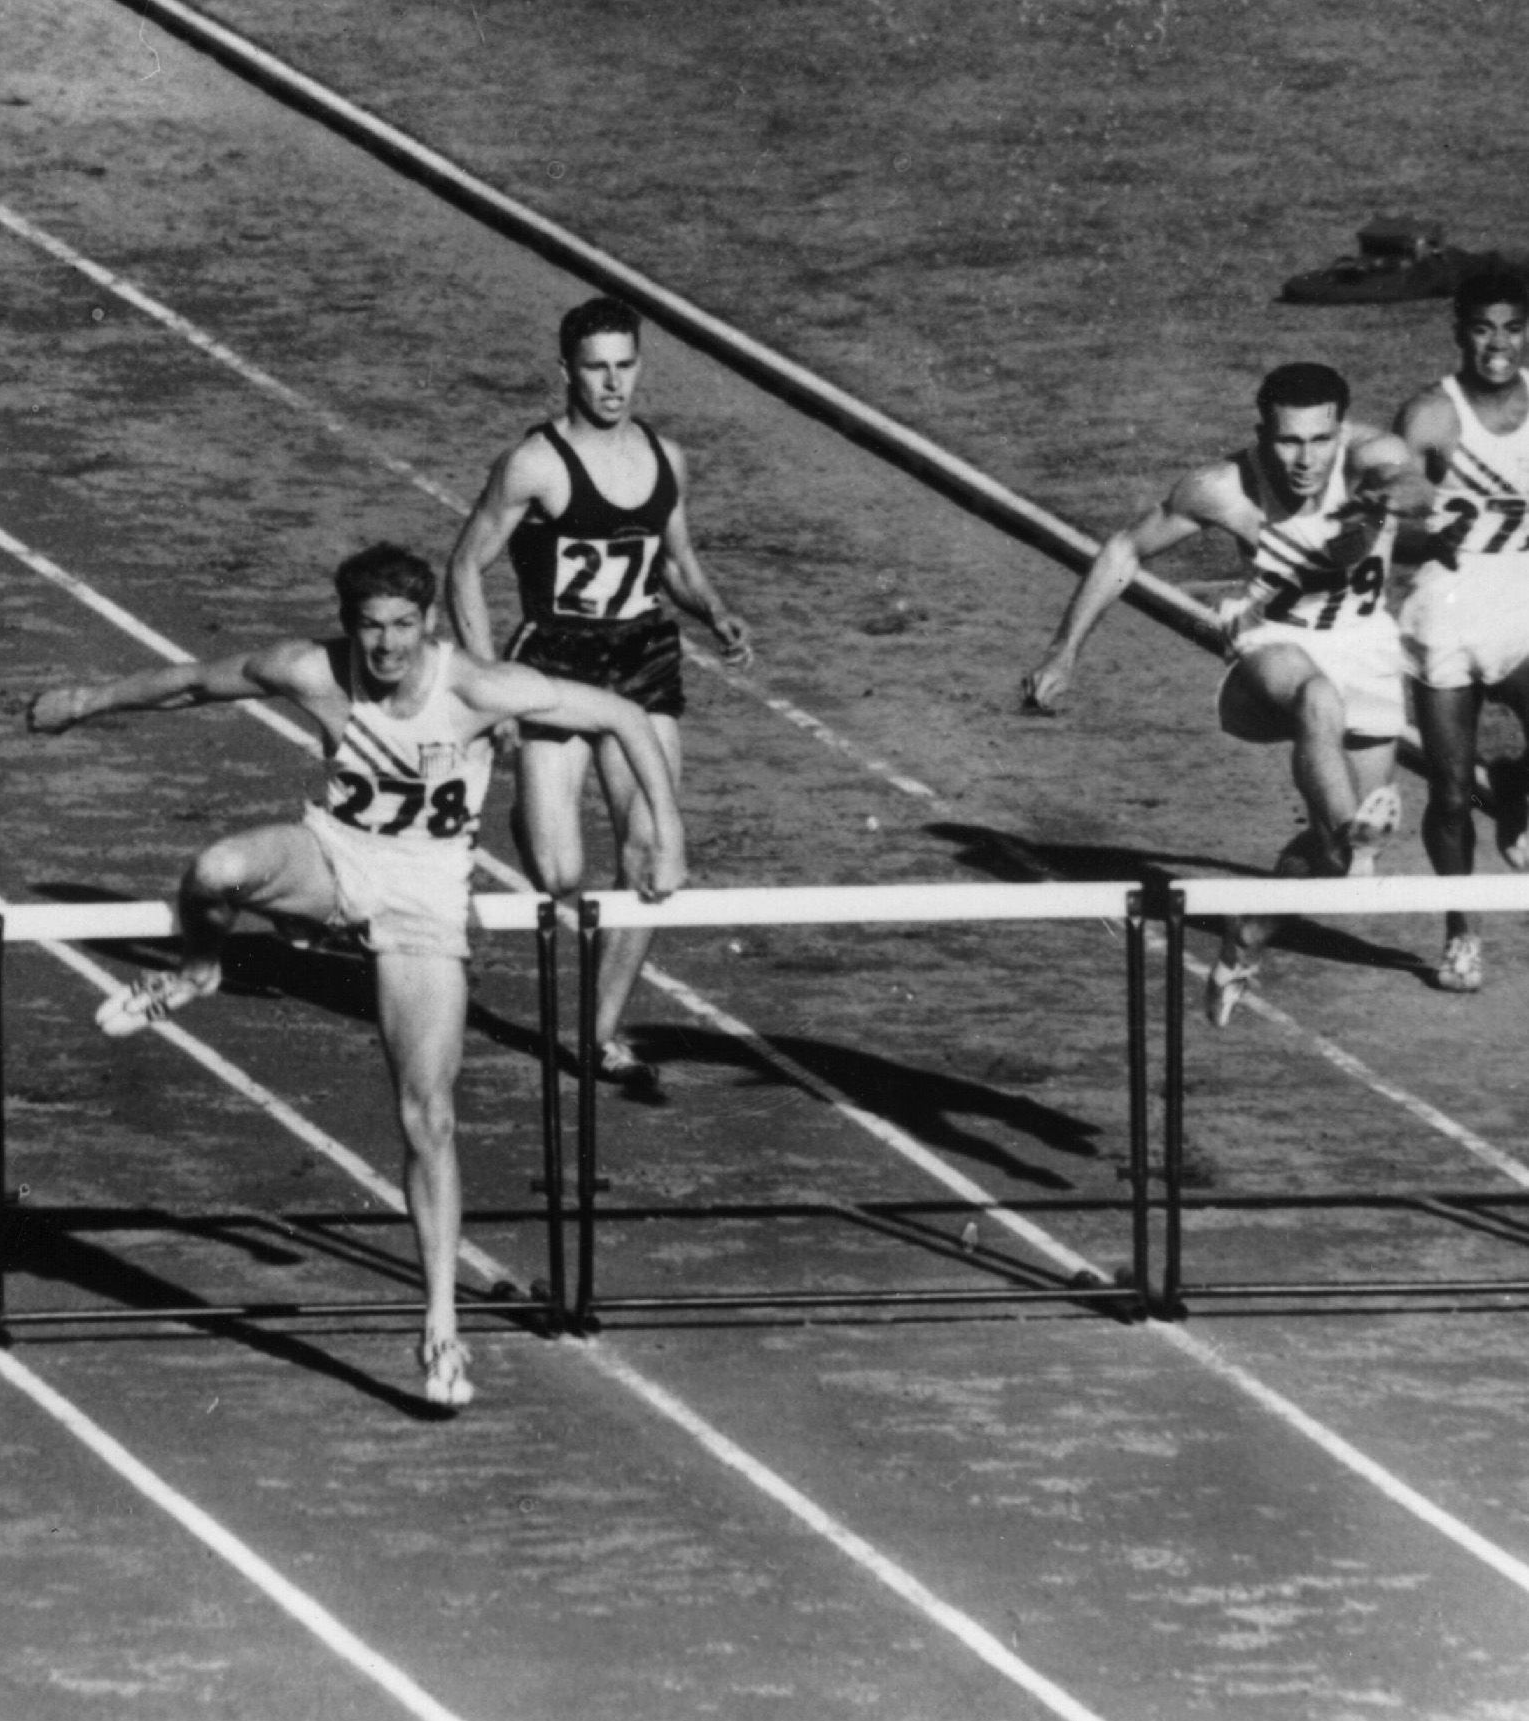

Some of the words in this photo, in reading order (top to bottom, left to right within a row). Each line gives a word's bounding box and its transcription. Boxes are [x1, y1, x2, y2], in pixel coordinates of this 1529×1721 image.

[1430, 497, 1529, 572] 27
[556, 539, 659, 619] 27
[332, 771, 471, 840] 278
